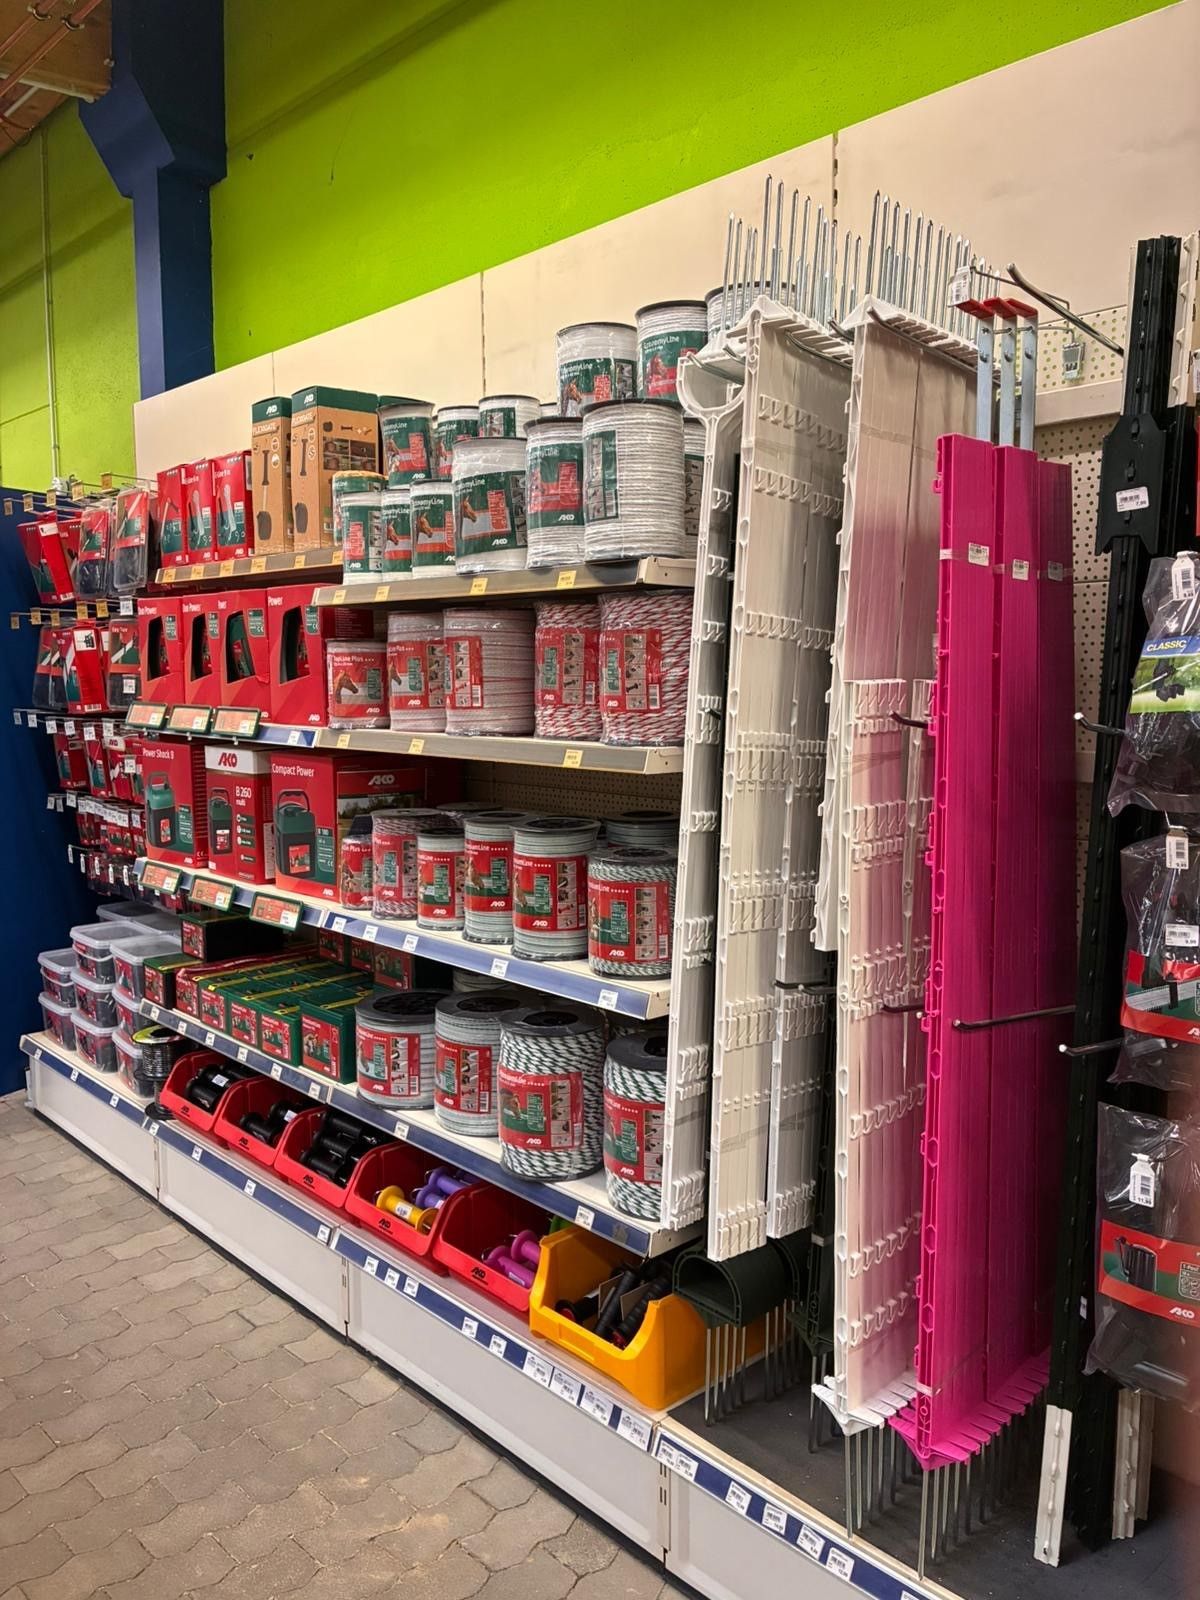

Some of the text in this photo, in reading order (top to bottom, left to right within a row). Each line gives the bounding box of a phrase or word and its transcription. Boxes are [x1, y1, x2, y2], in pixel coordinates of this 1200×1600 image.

[1147, 640, 1187, 652] CLASSIC
[308, 714, 320, 722] AKO
[143, 749, 156, 758] Power
[218, 752, 237, 768] AKO
[272, 763, 314, 777] Compact Power
[368, 775, 395, 786] AKO
[620, 1167, 634, 1175] AKO
[1169, 1307, 1195, 1318] AKO
